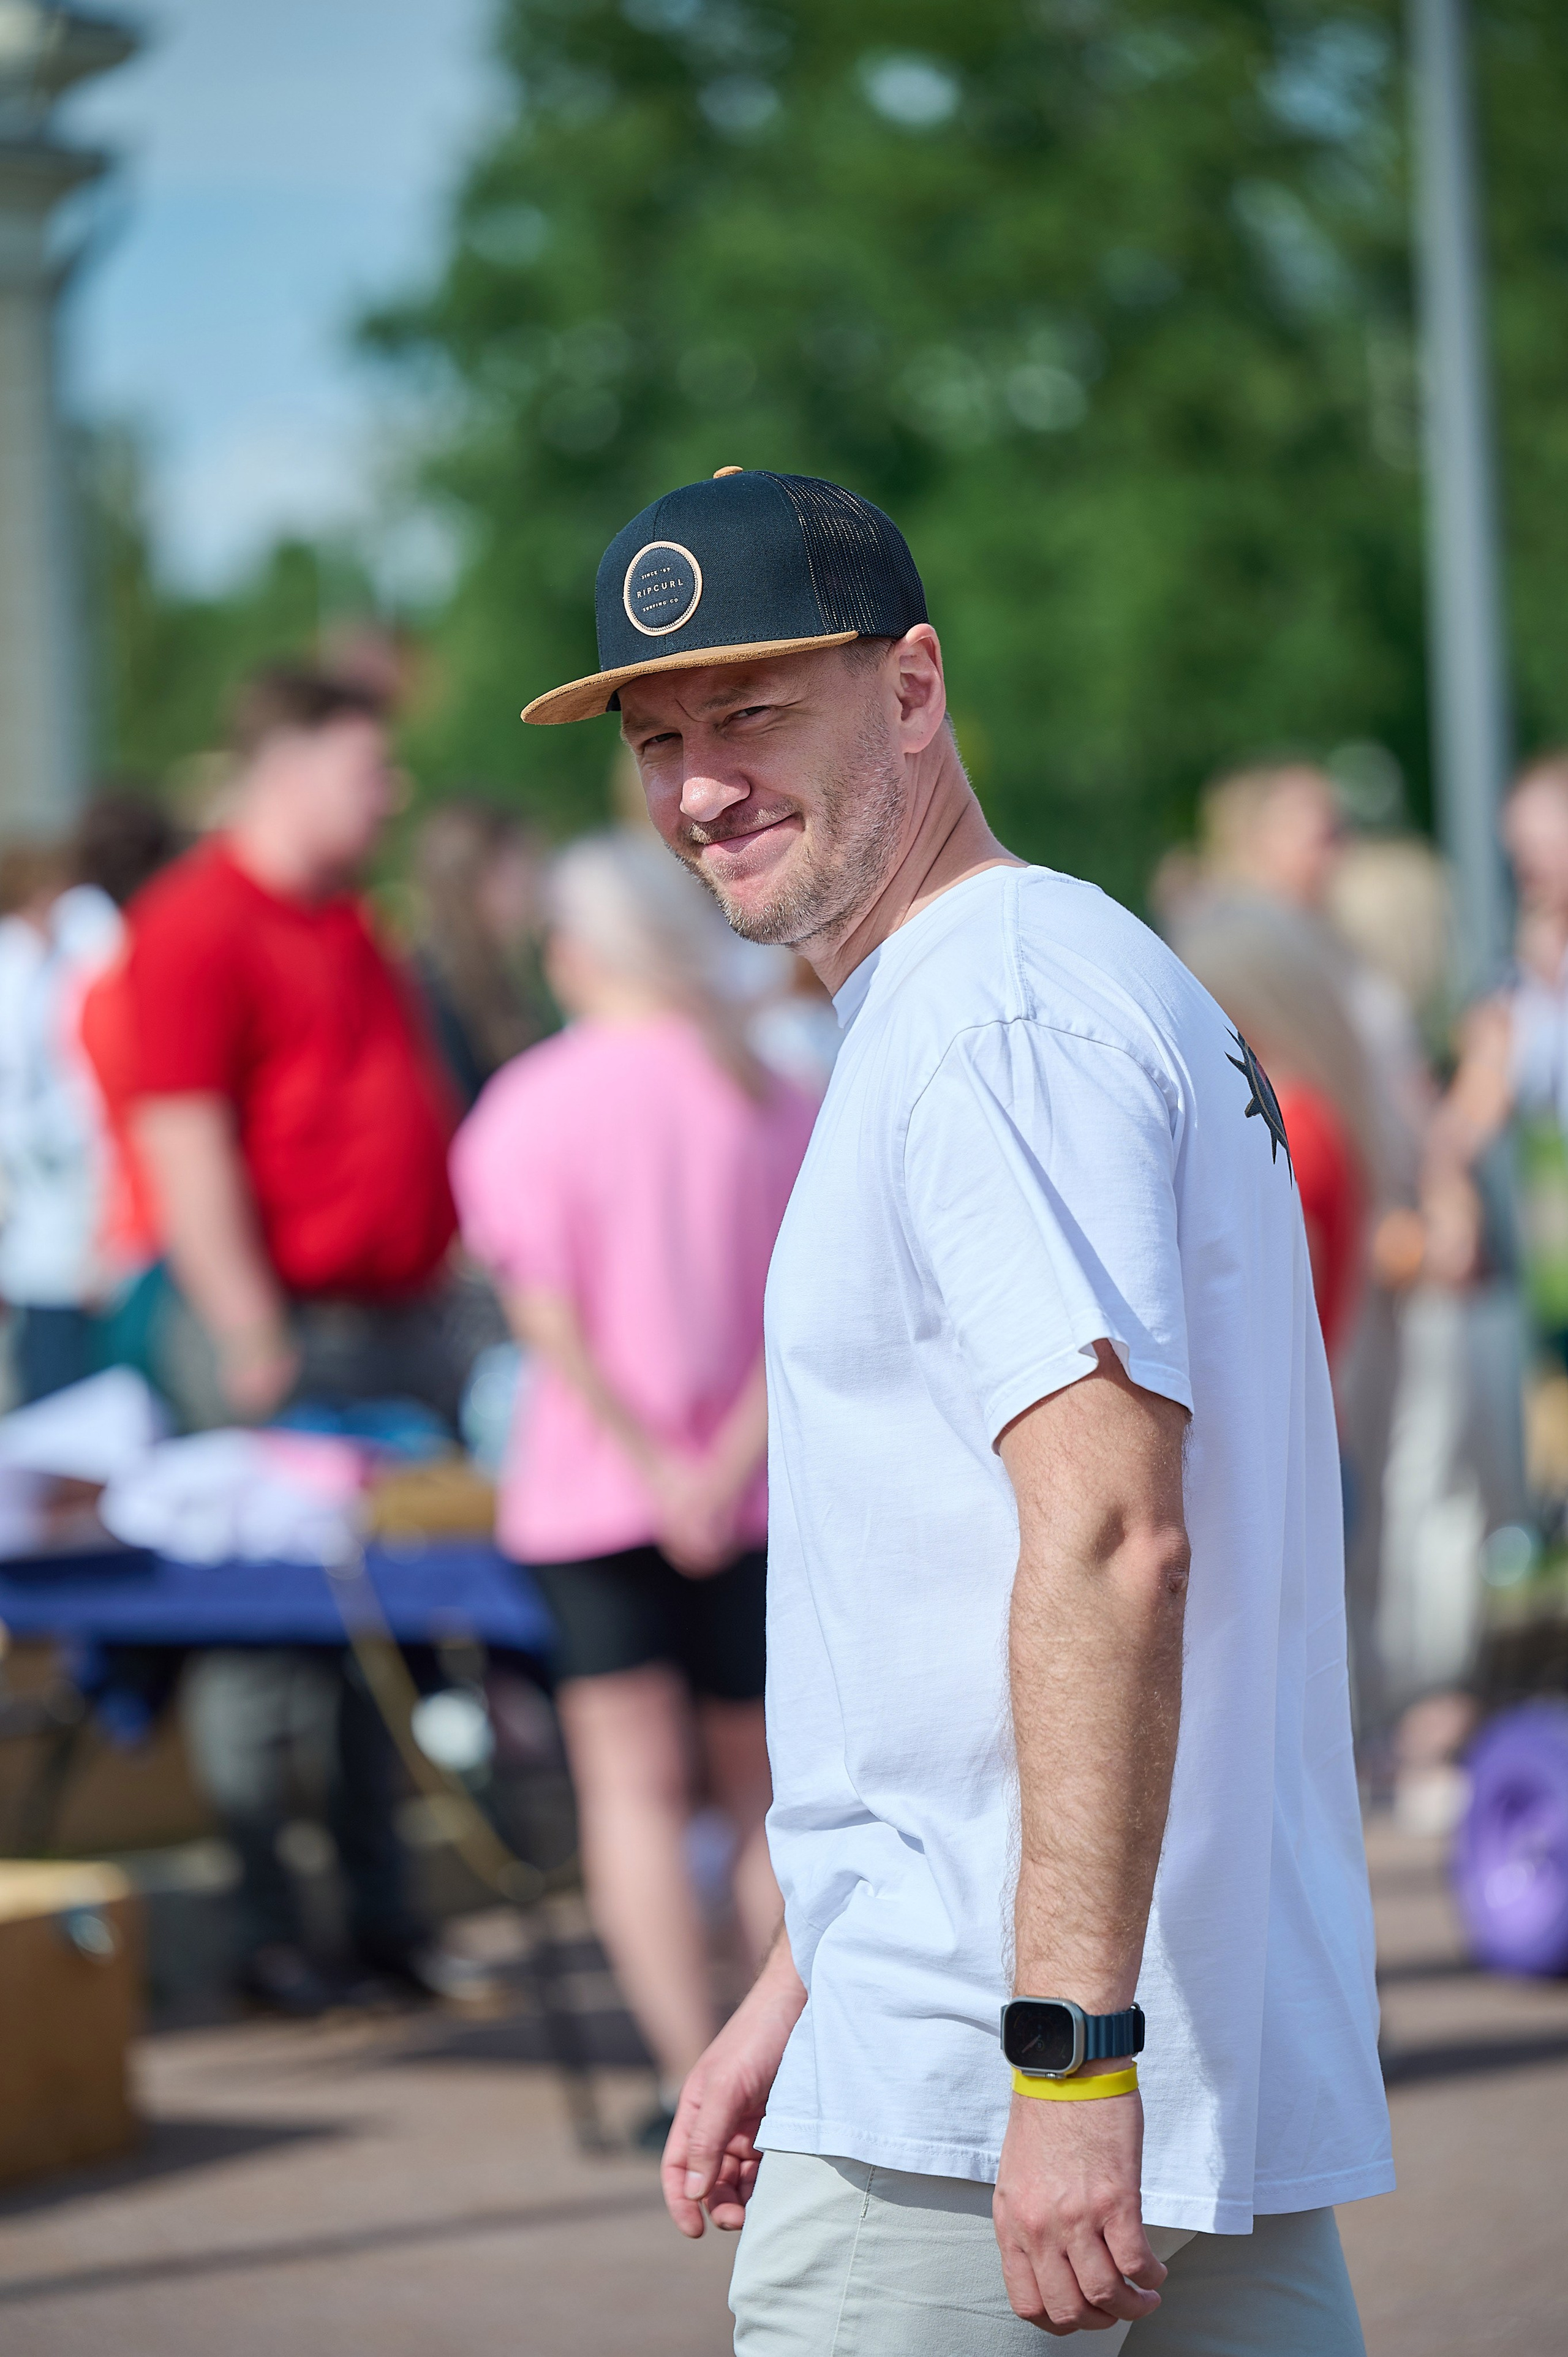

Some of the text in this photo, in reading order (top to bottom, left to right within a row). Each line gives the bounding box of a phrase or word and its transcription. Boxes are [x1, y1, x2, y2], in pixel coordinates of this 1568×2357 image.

[641, 570, 658, 579] SINCE
[637, 579, 684, 598] RIPCURL
[643, 601, 667, 612] SURFING
